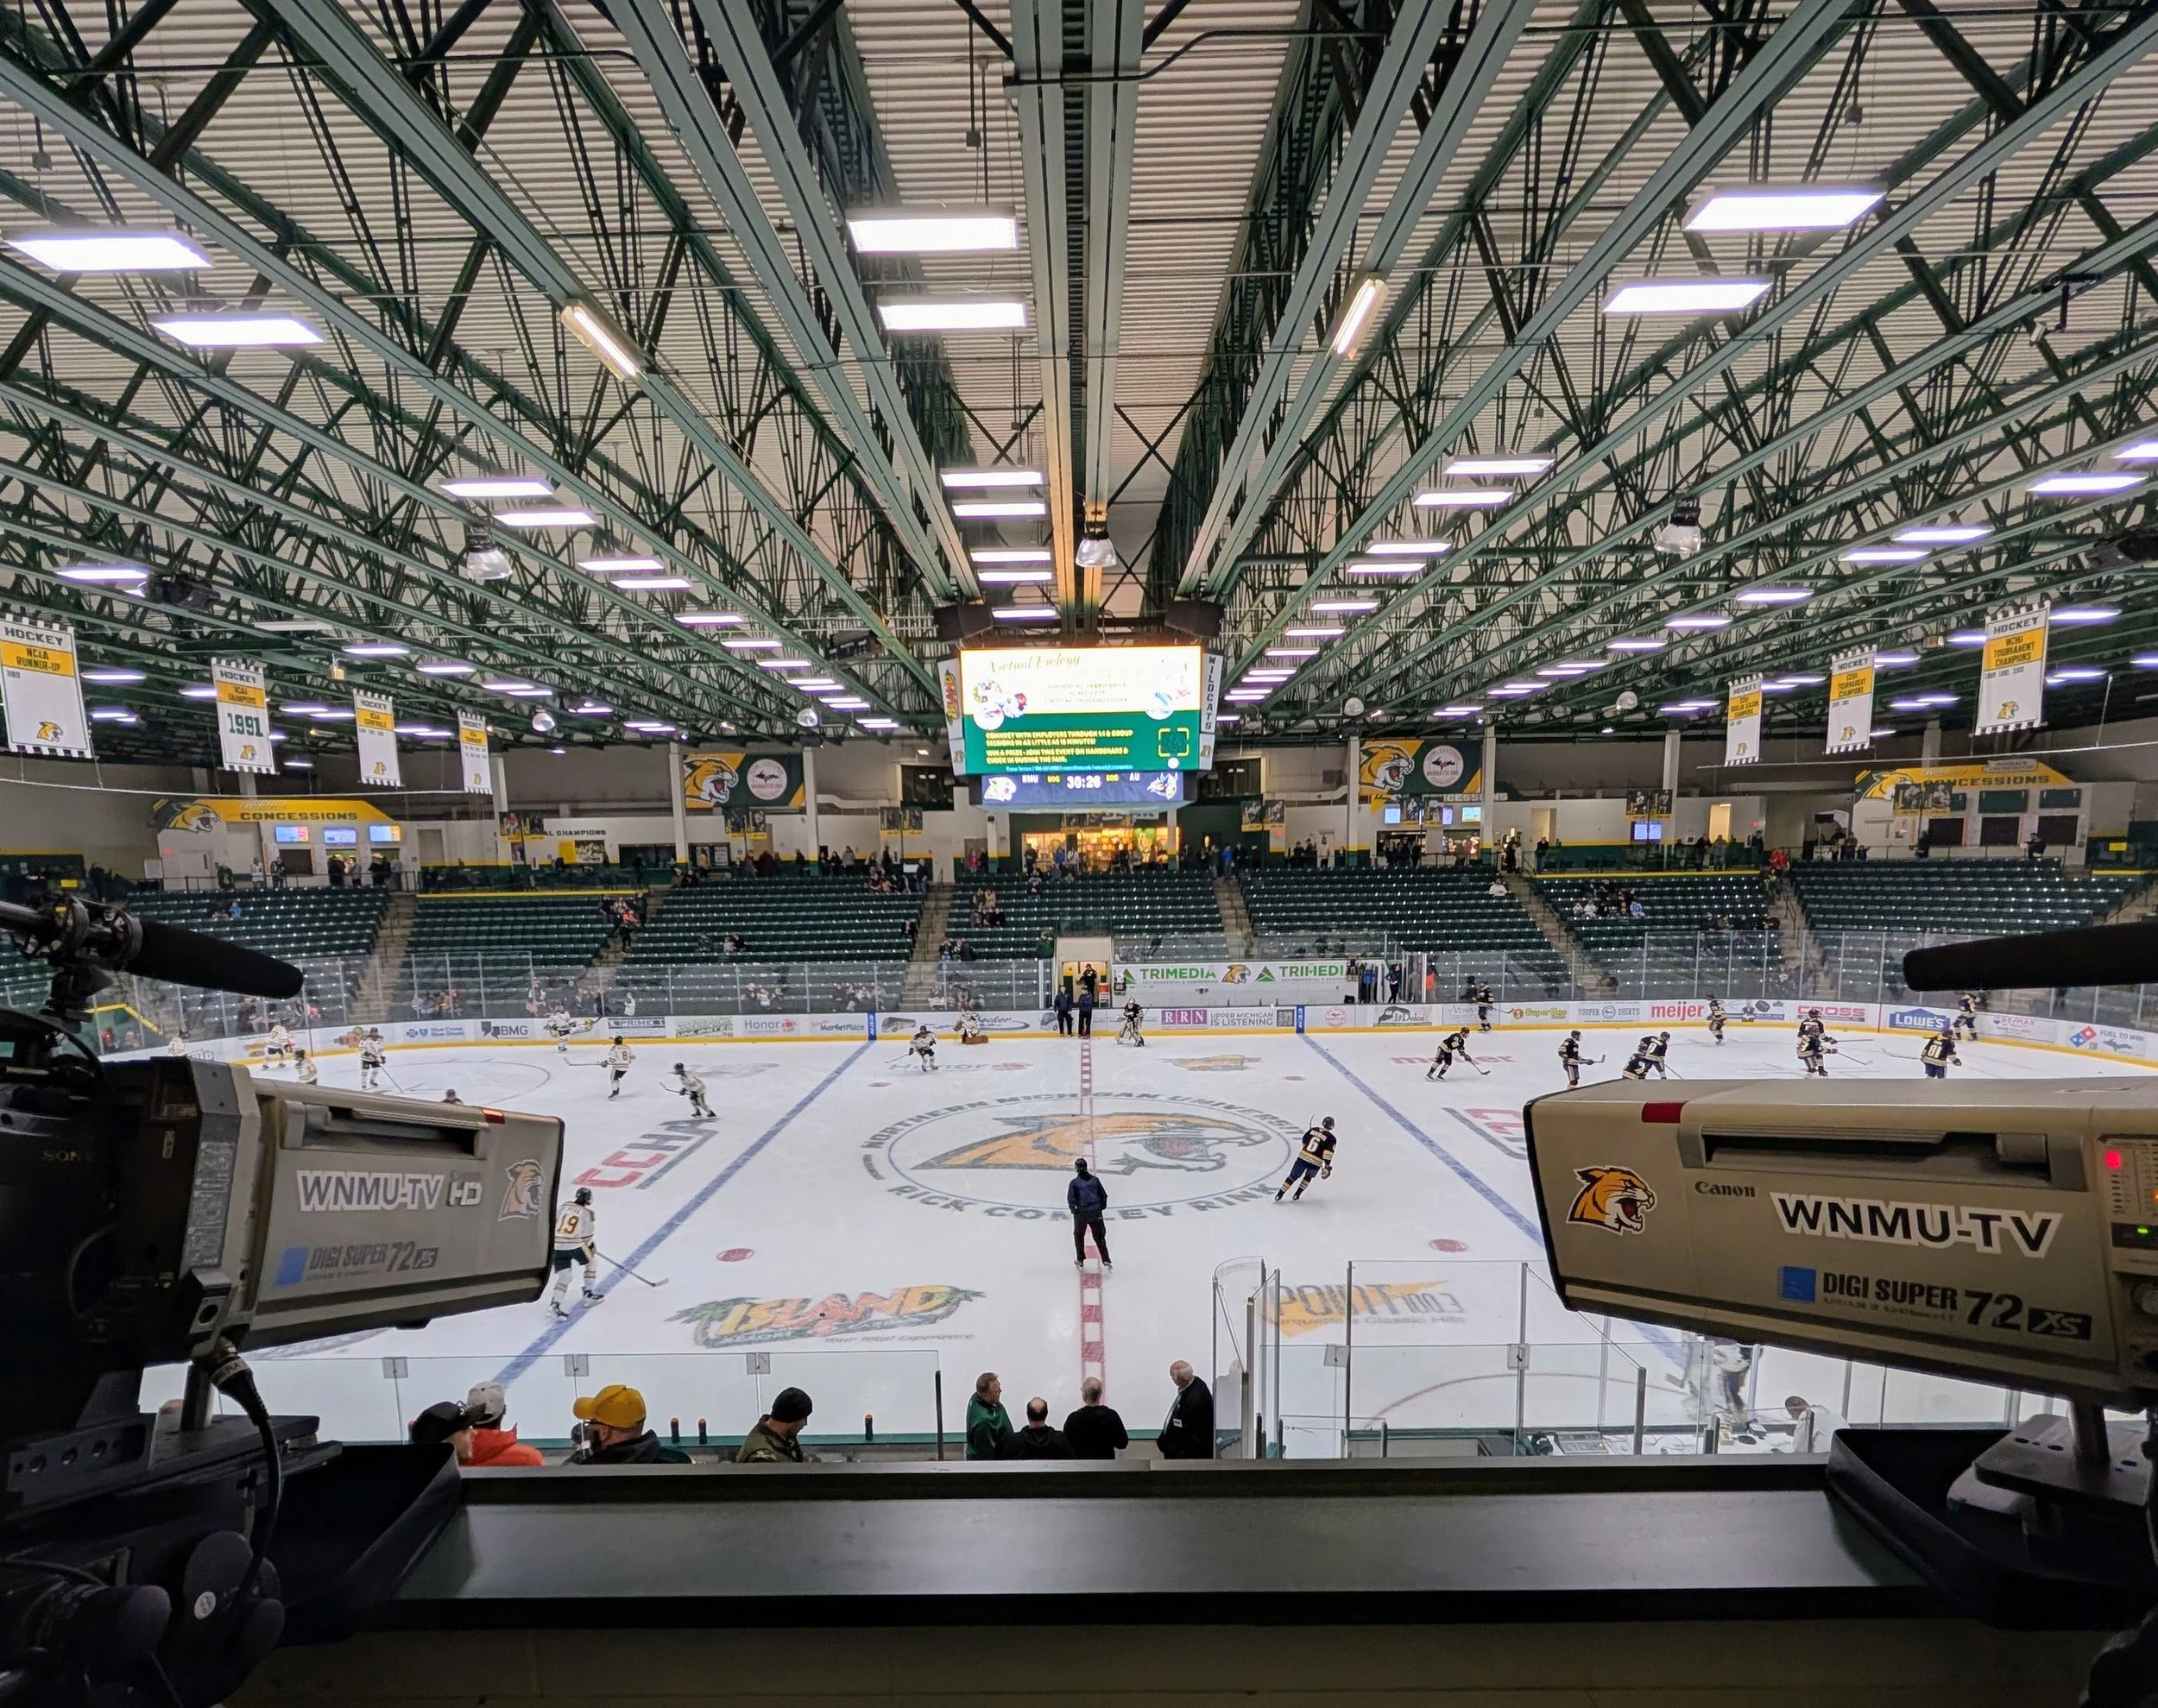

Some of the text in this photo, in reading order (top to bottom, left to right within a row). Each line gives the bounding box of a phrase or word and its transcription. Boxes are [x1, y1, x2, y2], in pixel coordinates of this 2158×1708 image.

[1993, 616, 2038, 634] HOCKEY
[4, 627, 63, 646] HOCKEY
[16, 656, 61, 671] RUNNER-UP
[1838, 658, 1869, 670] HOCKEY
[1995, 652, 2032, 667] CHAMPIONS
[220, 671, 256, 684] HOCKEY
[1205, 656, 1216, 730] WILDCATS
[227, 712, 264, 737] 1991
[240, 812, 357, 821] CONCESSIONS
[1139, 967, 1216, 980] TRIMEDIA
[1278, 964, 1348, 977] TRIMEDI
[1403, 1012, 1425, 1021] Dolce
[1618, 1007, 1640, 1016] SHIRTS
[1650, 1001, 1704, 1021] meijer
[744, 1018, 780, 1030] Honor
[1895, 1013, 1945, 1028] LOWE'S
[501, 1024, 529, 1036] BMG
[2099, 1029, 2117, 1038] FUEL
[861, 1100, 990, 1149] NORTHERN
[995, 1092, 1161, 1104] MICHGAN
[1307, 1136, 1322, 1152] 6
[573, 1119, 719, 1188] CCHA
[300, 1174, 483, 1208] WNMU-TV HD
[887, 1184, 975, 1213] RICK
[1187, 1182, 1278, 1211] RINK
[1694, 1181, 1756, 1198] Canon
[556, 1213, 579, 1234] 19
[1778, 1198, 2053, 1251] WNMU-TV
[309, 1247, 342, 1270] DIGI
[344, 1244, 388, 1267] SUPER
[387, 1241, 415, 1272] 72
[1279, 1284, 1401, 1316] POINT
[1822, 1271, 1870, 1299] DIGI
[1875, 1278, 1958, 1311] SUPER
[1965, 1289, 2023, 1332] 72
[2033, 1311, 2085, 1334] XS
[716, 1284, 947, 1337] ISLAND
[1364, 1315, 1423, 1324] Classic
[1431, 1314, 1467, 1324] Hits
[899, 1333, 975, 1341] Experience
